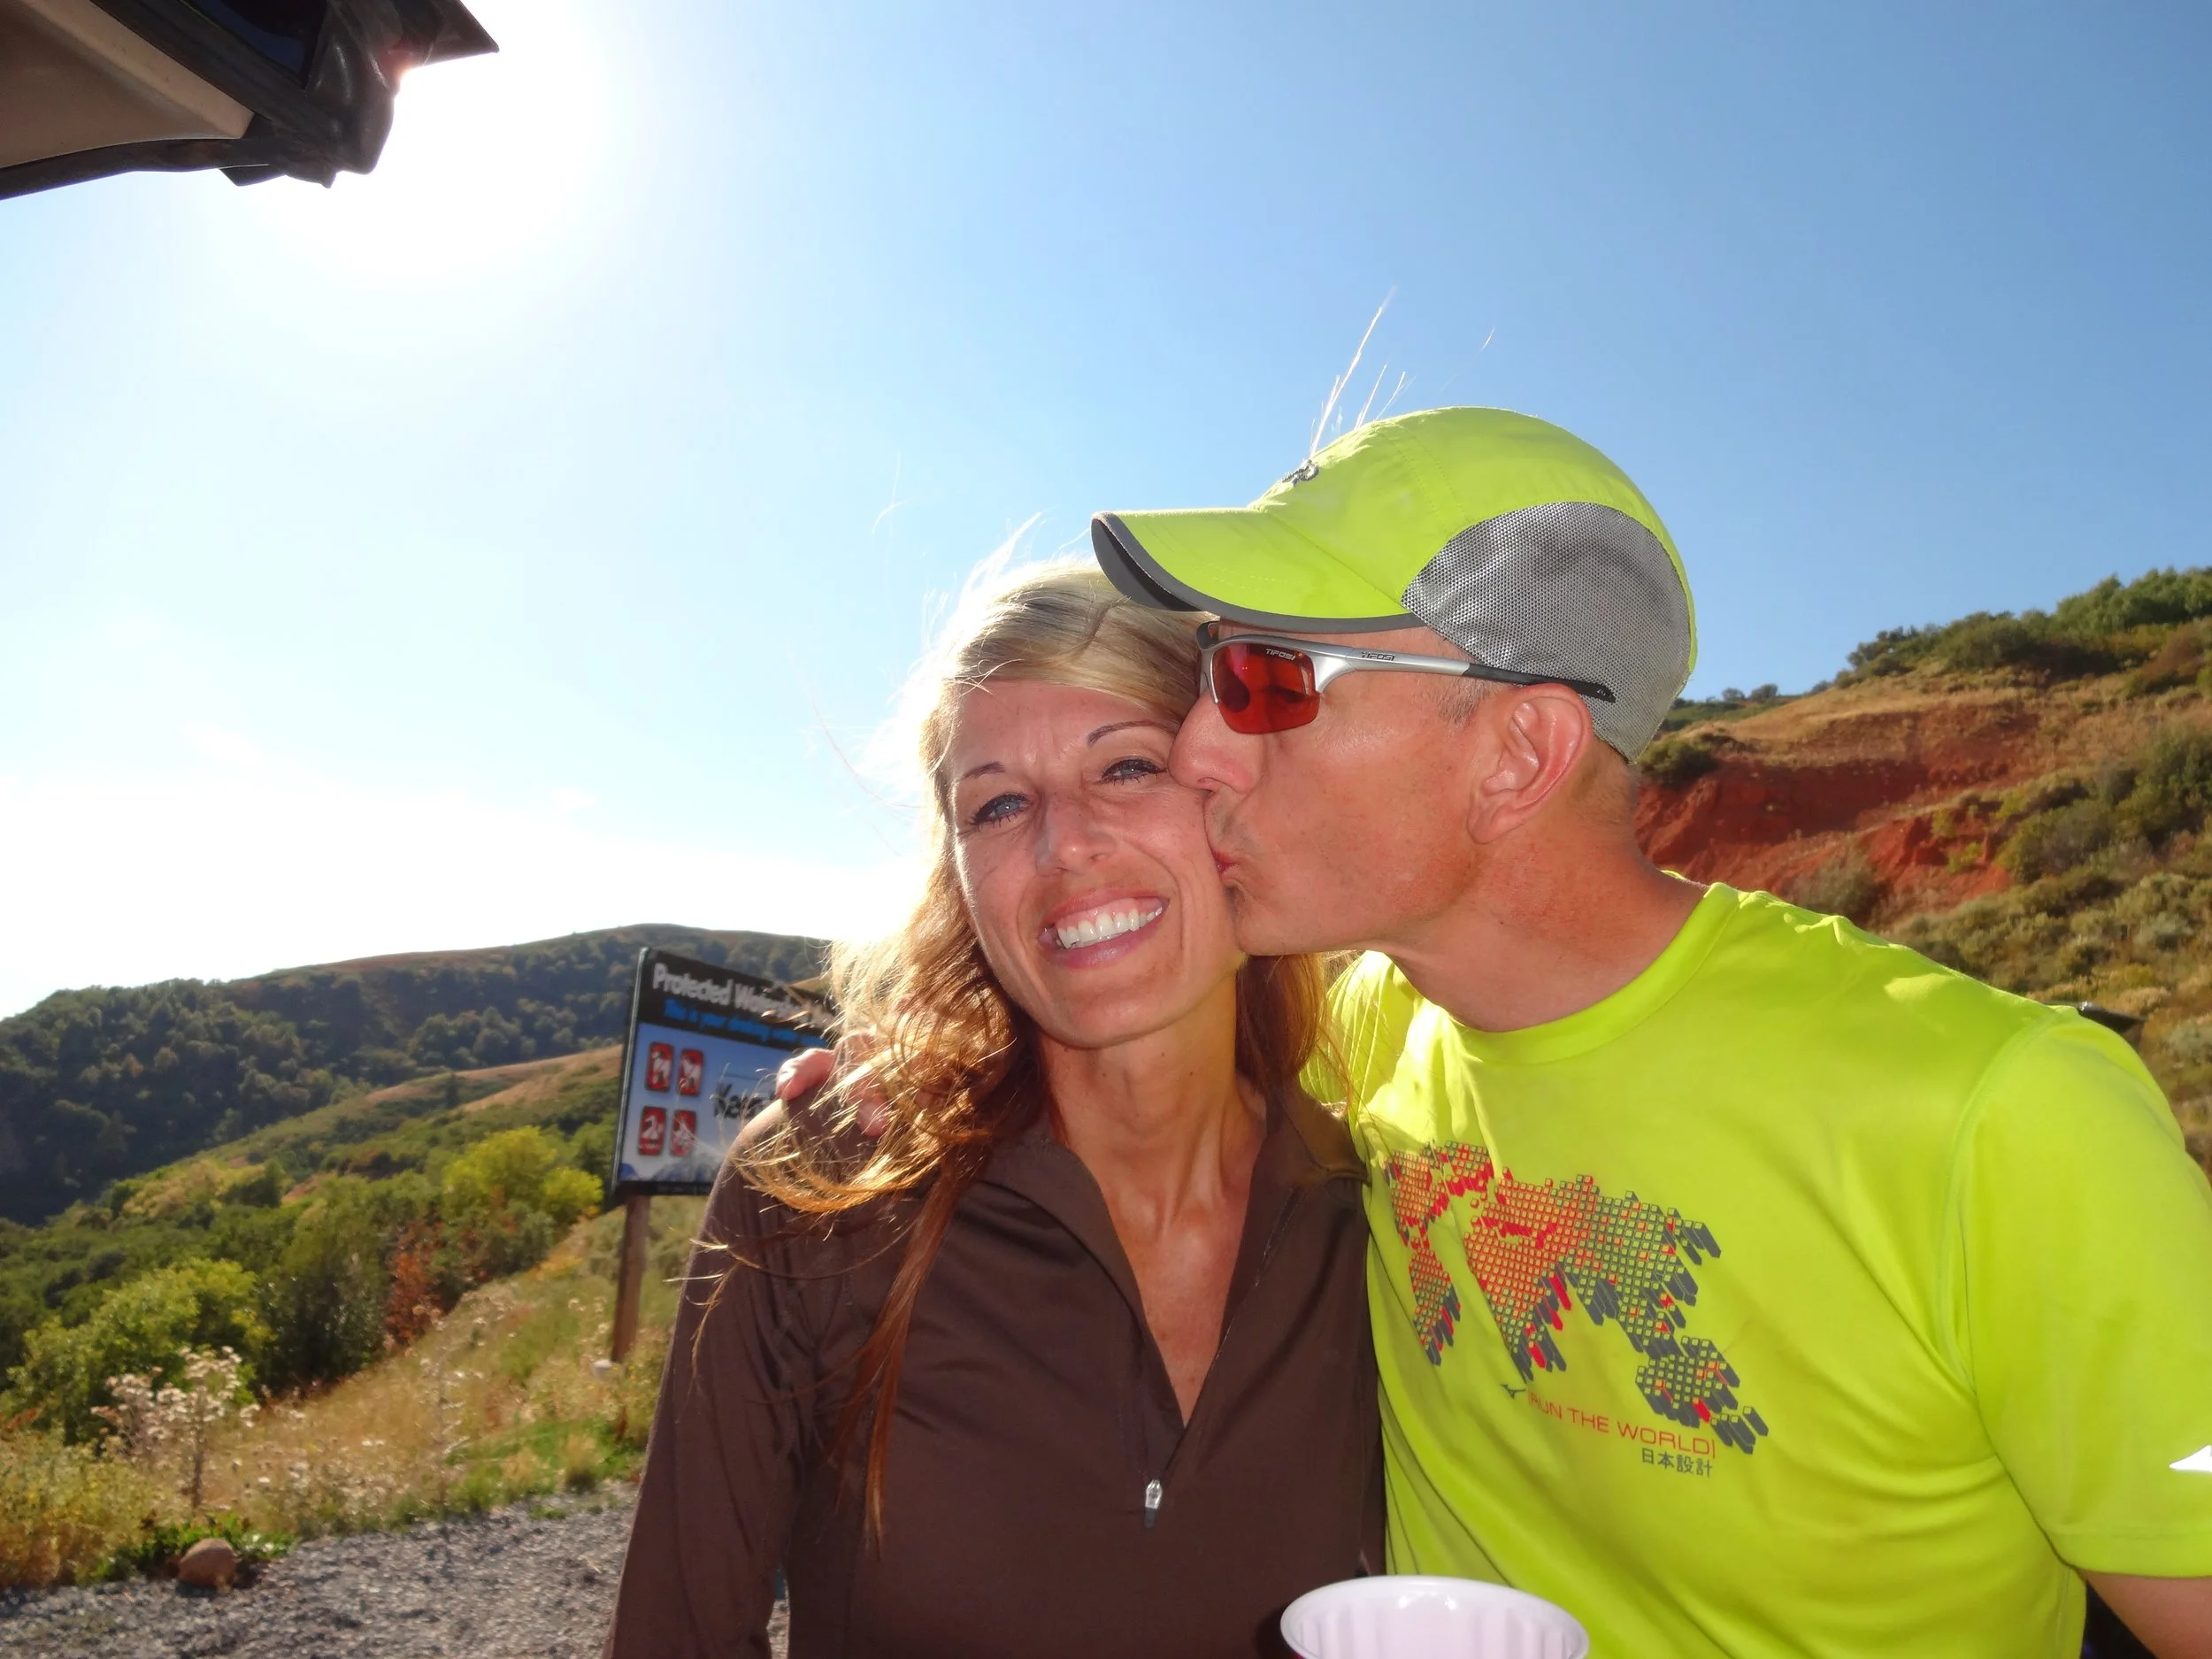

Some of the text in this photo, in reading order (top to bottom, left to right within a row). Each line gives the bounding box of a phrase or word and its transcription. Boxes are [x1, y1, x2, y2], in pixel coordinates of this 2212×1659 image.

[1265, 648, 1296, 661] TIFOSI
[1361, 651, 1395, 661] TIFOSI
[652, 962, 734, 1006] Protected
[1568, 1407, 1609, 1433] THE
